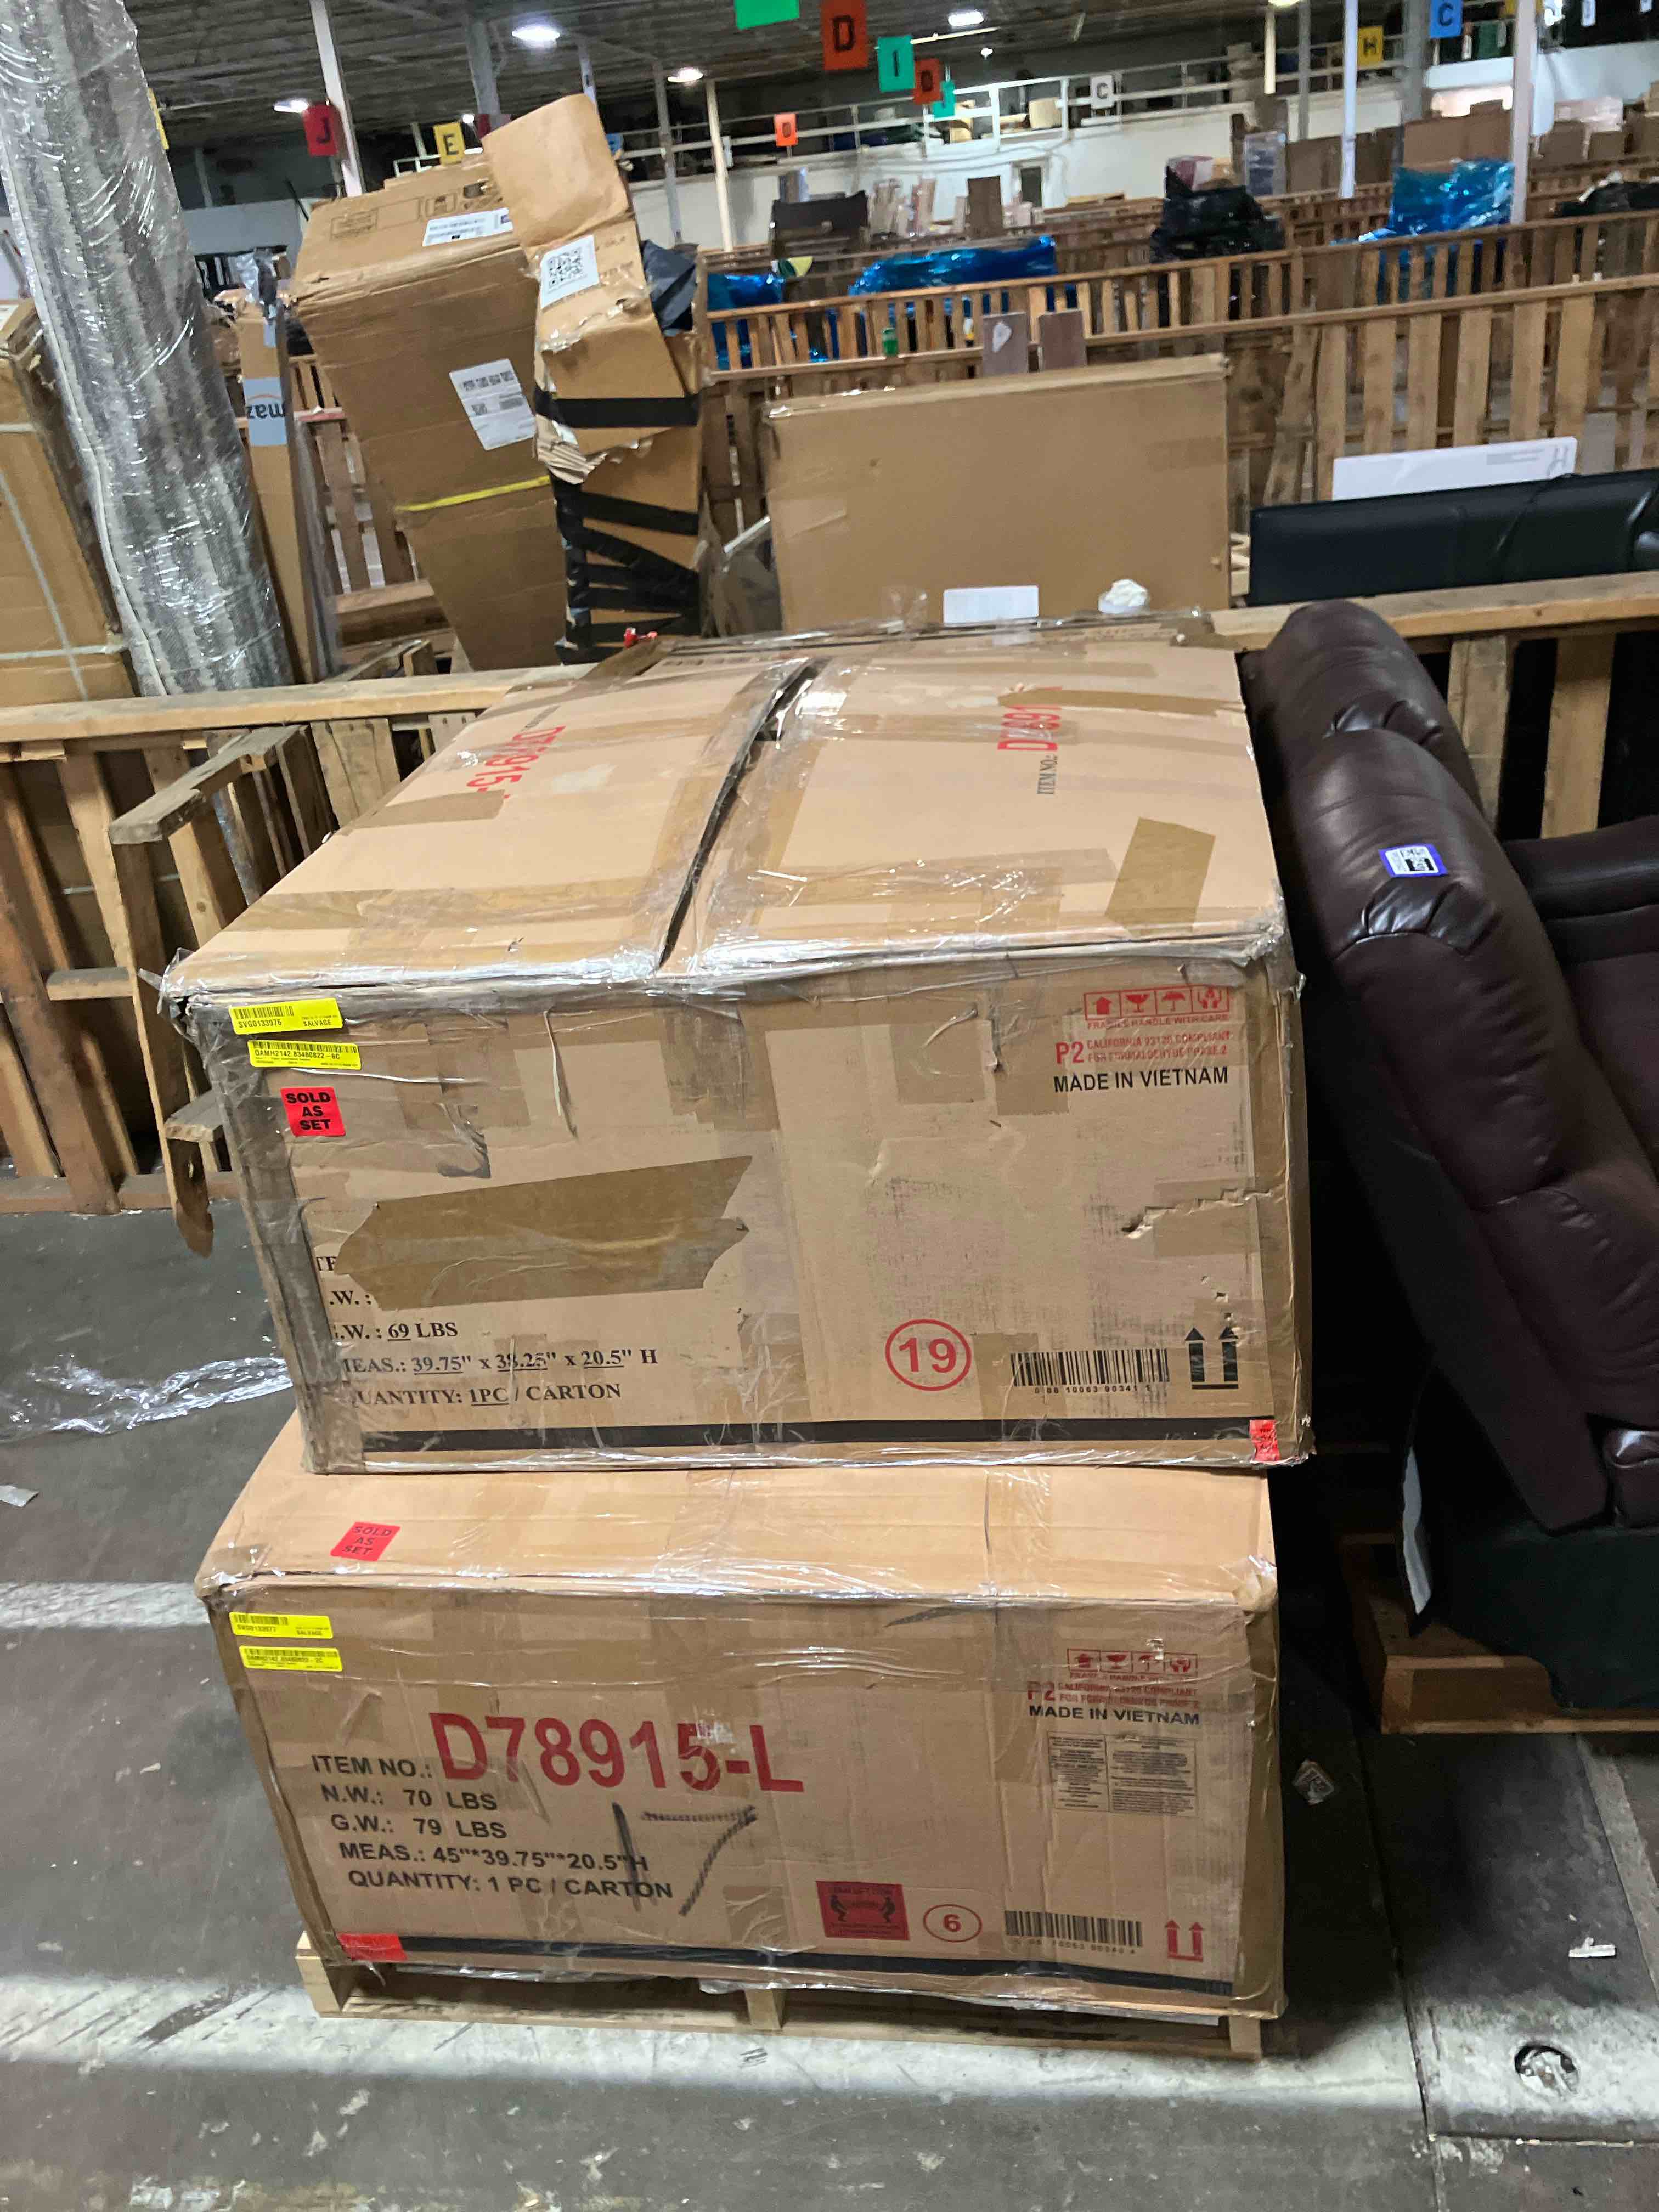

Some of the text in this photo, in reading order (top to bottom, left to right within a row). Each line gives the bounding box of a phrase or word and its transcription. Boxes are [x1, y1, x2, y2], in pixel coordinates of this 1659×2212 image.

[1439, 2, 1453, 26] C
[832, 15, 855, 52] D
[317, 116, 330, 144] J
[443, 134, 459, 155] E
[1056, 1041, 1085, 1064] P2
[1053, 1066, 1228, 1093] MADE IN VIETNAM
[286, 1092, 331, 1104] SOLD
[302, 1105, 324, 1117] AS
[299, 1119, 331, 1130] SET
[388, 1323, 411, 1341] 69
[415, 1322, 458, 1338] LBS
[478, 1358, 492, 1370] x
[564, 1355, 577, 1367] x
[581, 1348, 632, 1368] 20.5"
[641, 1348, 658, 1364] H
[898, 1336, 957, 1373] 19
[352, 1387, 463, 1408] UANTITY:
[470, 1387, 508, 1403] 1PC
[526, 1384, 622, 1401] CARTON
[352, 1526, 392, 1537] SOLD
[354, 1537, 375, 1545] AS
[342, 1545, 373, 1555] SET
[1027, 1680, 1055, 1701] P2
[1029, 1705, 1200, 1725] MADE IN VIETNAM
[311, 1712, 804, 1793] ITEM NO.: D78915-L
[320, 1784, 498, 1811] N.W.: 70 LBS
[330, 1814, 507, 1839] G.W.: 79 LBS
[338, 1842, 426, 1863] MEAS.:
[347, 1869, 481, 1892] QUANTITY:
[487, 1876, 499, 1892] 1
[508, 1876, 543, 1894] PC
[563, 1878, 674, 1899] CARTON
[943, 1913, 962, 1933] 6
